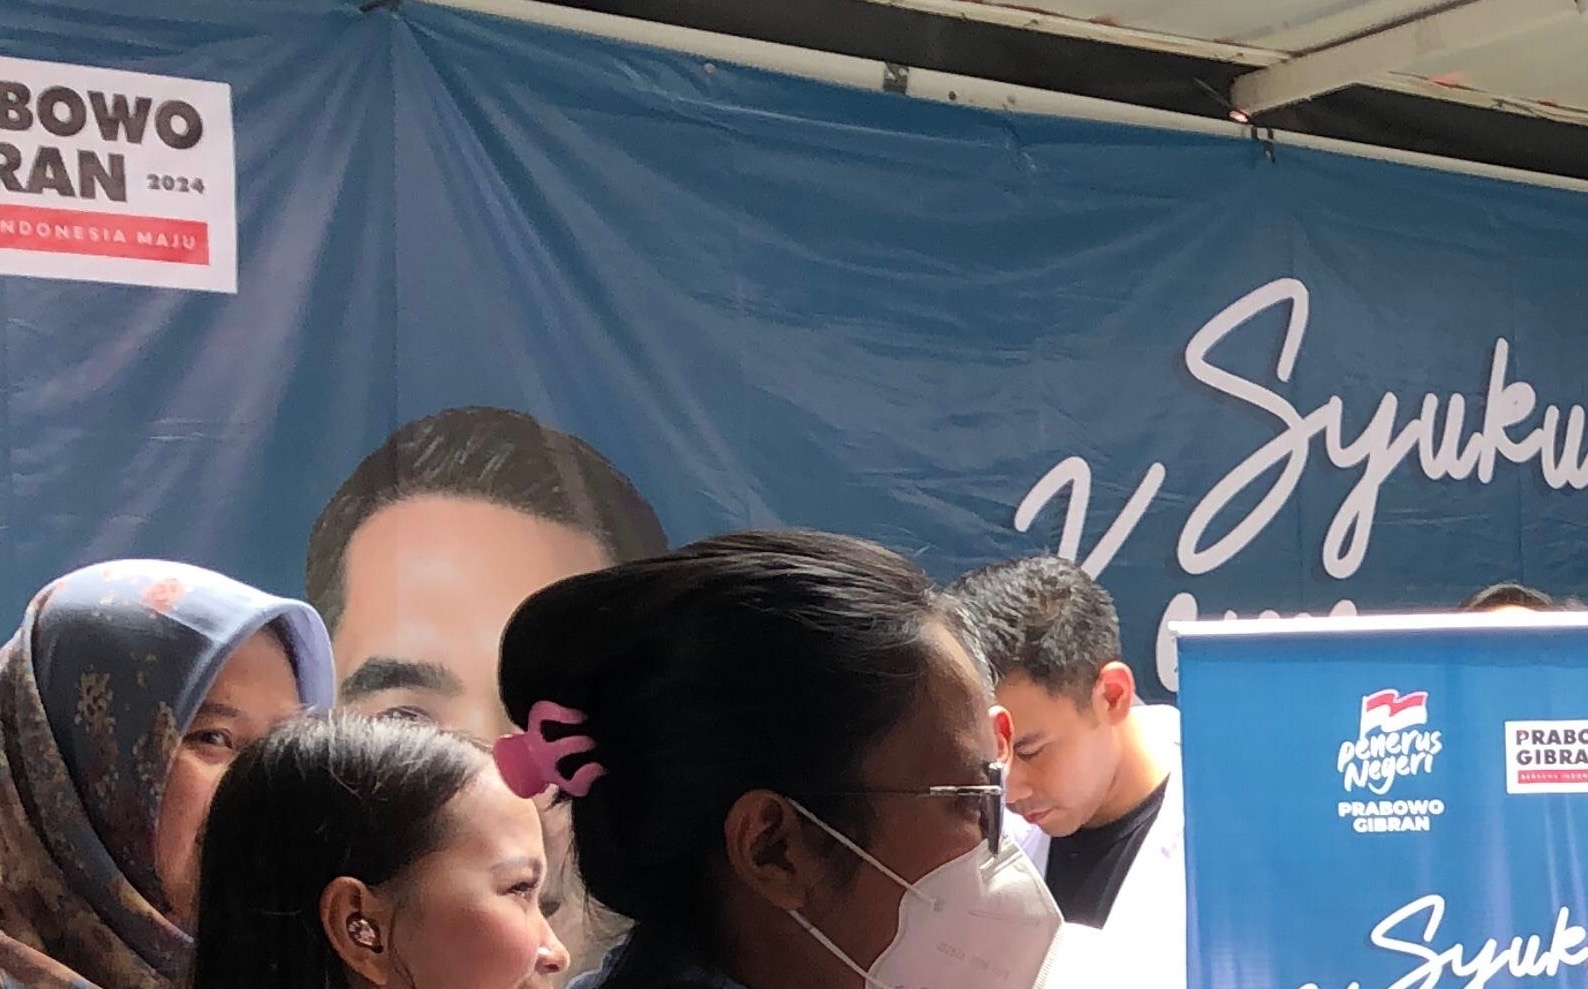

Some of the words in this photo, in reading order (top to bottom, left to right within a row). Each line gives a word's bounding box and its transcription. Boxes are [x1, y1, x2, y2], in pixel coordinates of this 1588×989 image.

[146, 173, 205, 195] 2024
[137, 230, 196, 250] MAJU
[1337, 729, 1443, 773] Penerus
[1344, 751, 1433, 795] Negeri
[1338, 799, 1445, 818] PRABOWO
[1353, 816, 1431, 833] GIBRAN
